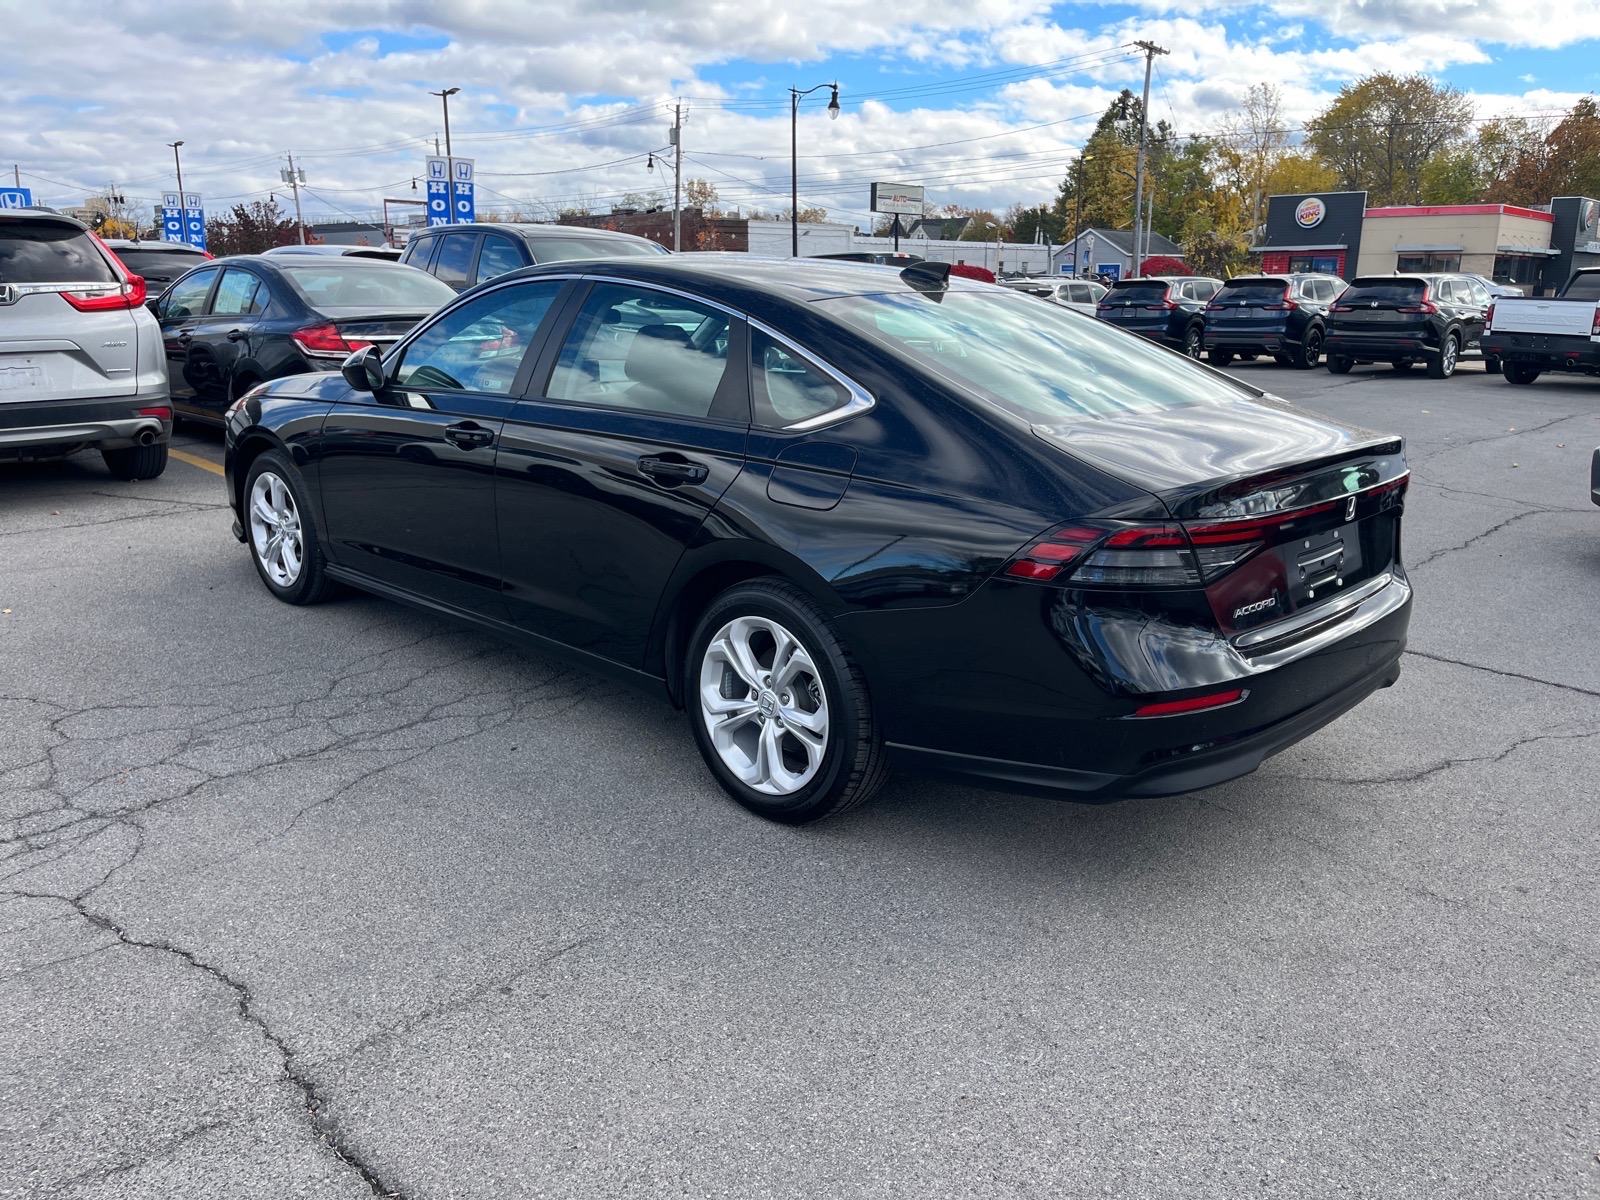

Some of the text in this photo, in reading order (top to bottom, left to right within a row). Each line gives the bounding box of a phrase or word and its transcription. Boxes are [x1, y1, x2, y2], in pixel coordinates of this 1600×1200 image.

[892, 194, 908, 202] AUTO
[1300, 209, 1320, 220] KING
[1232, 597, 1276, 619] ACCORD
